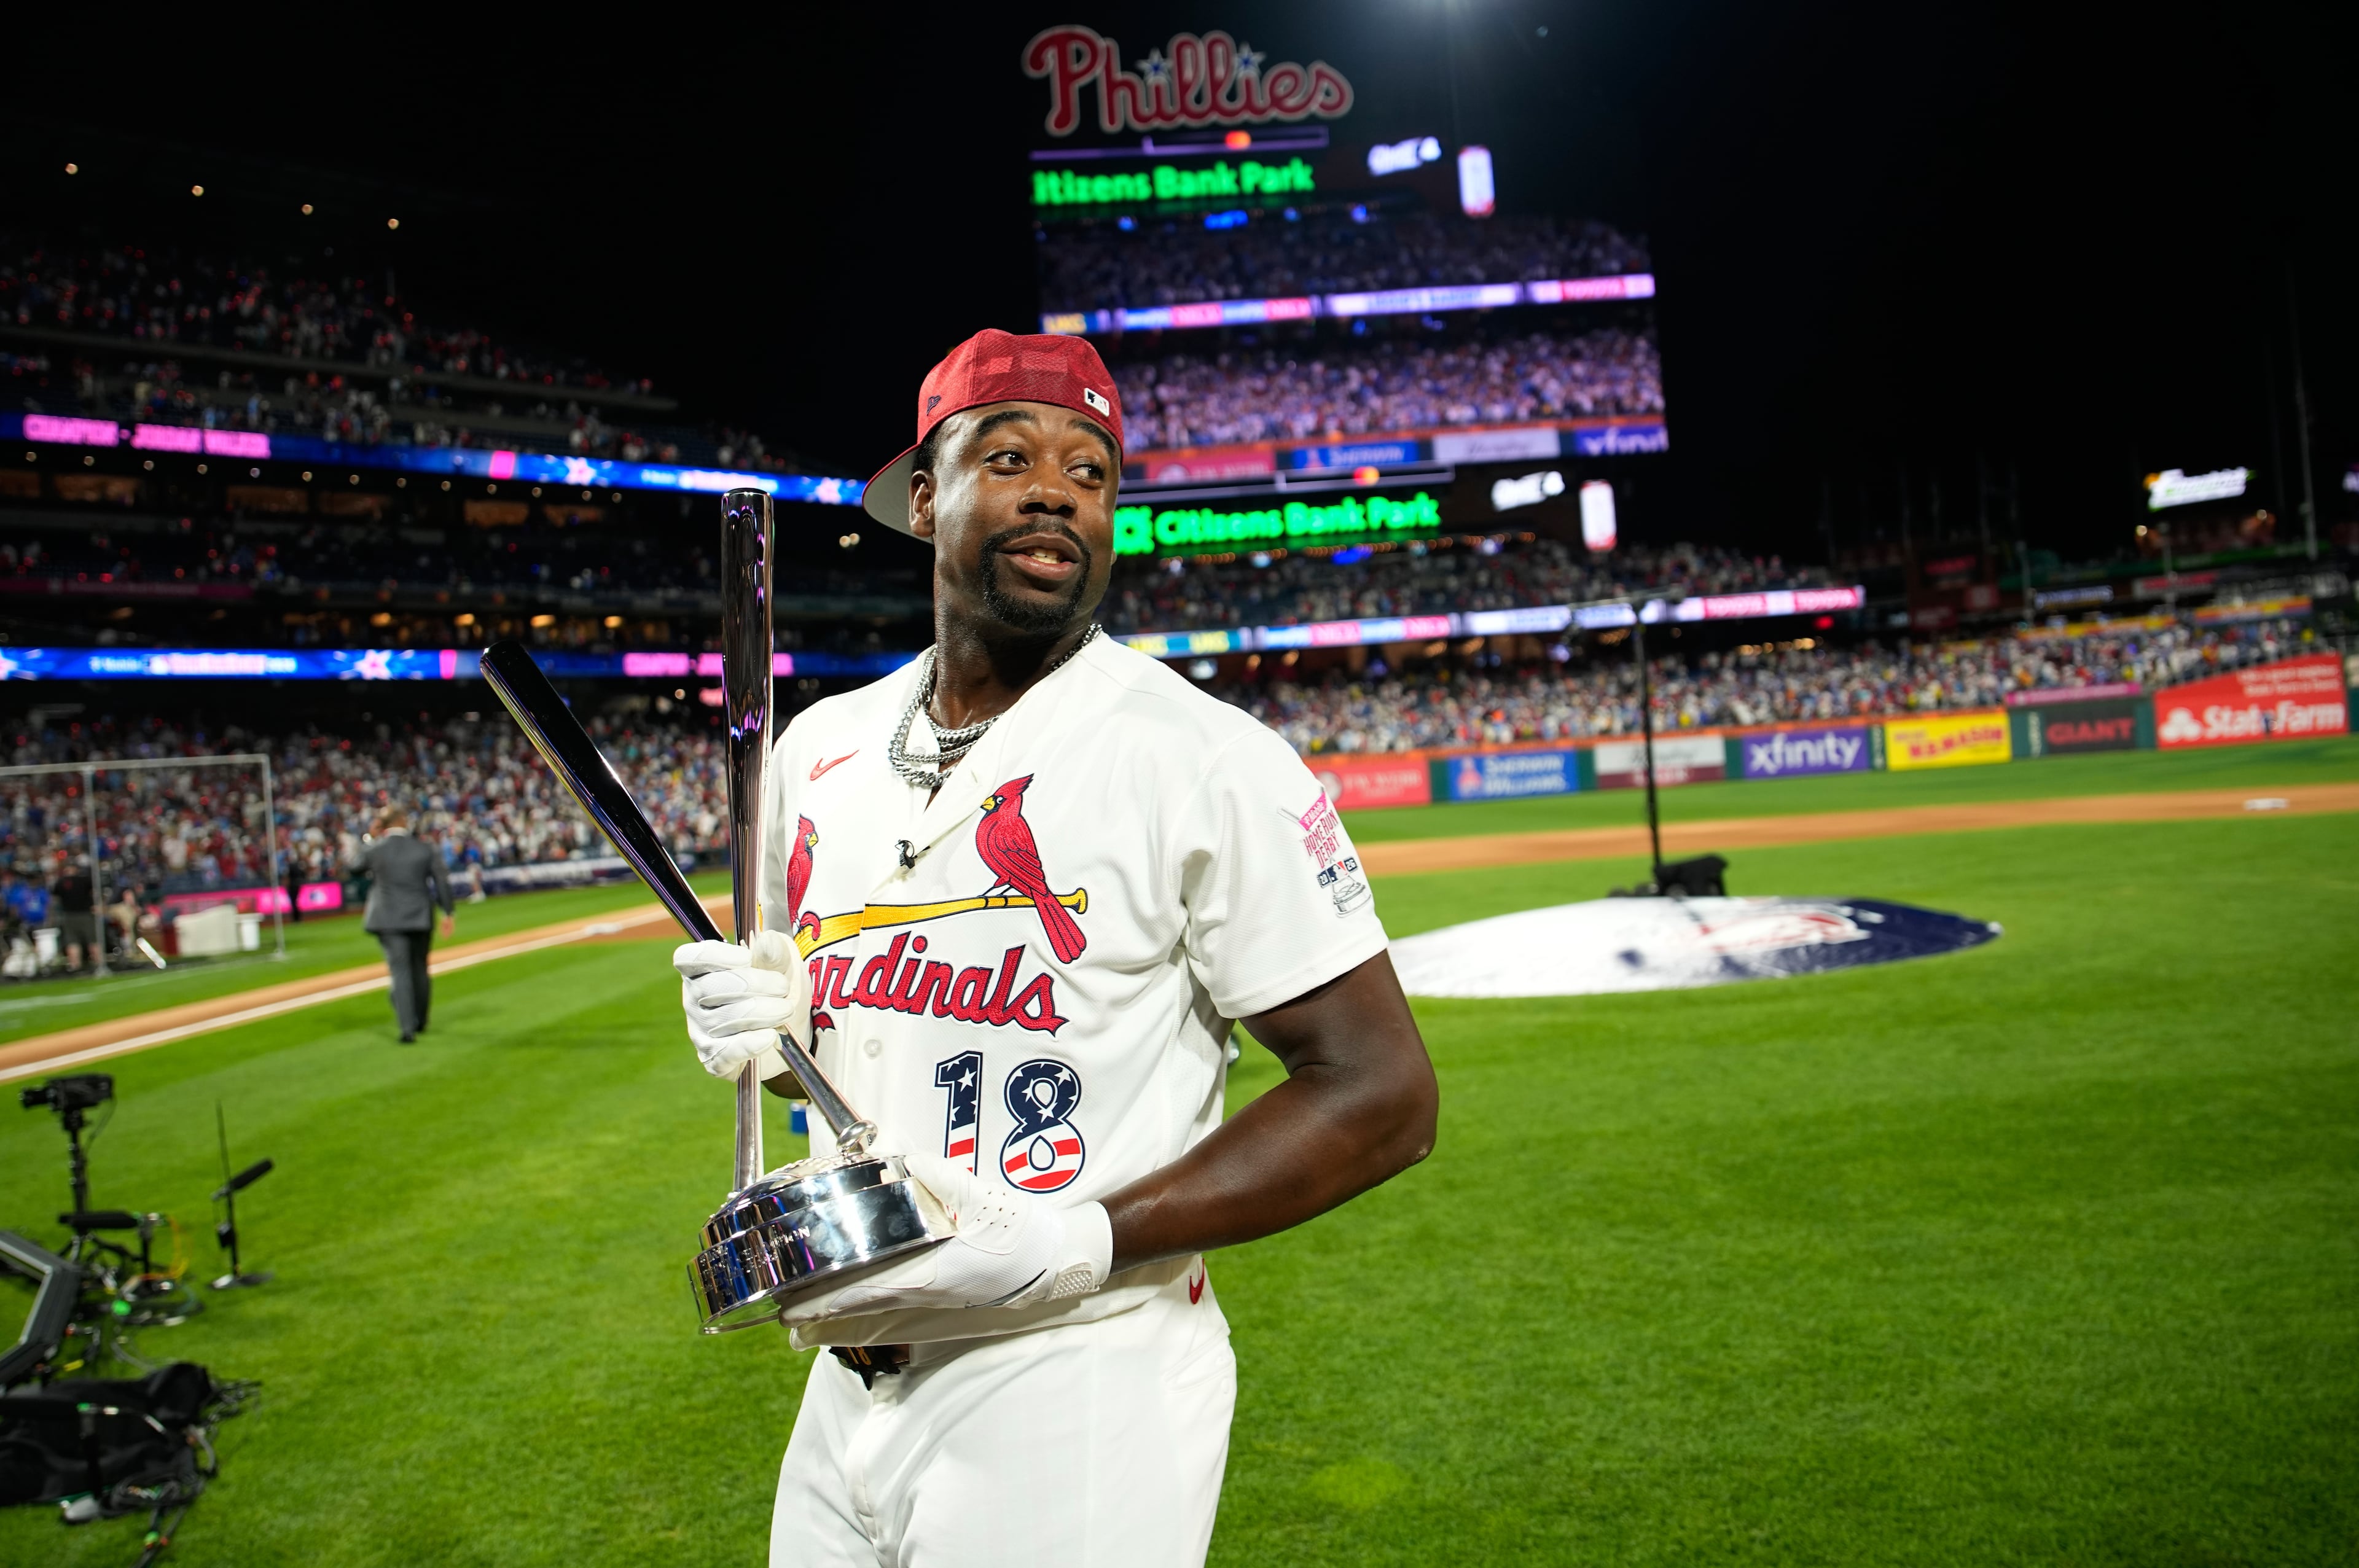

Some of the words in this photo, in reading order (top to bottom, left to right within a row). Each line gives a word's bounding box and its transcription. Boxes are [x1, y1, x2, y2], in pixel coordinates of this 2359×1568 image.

[1022, 25, 1354, 137] Phillies
[1032, 170, 1152, 205] itizens
[1153, 160, 1239, 199] Bank
[1240, 156, 1315, 194] Park
[1154, 508, 1284, 545] Citizens
[1283, 496, 1367, 536] Bank
[1367, 491, 1441, 529] Park
[2047, 718, 2135, 744] GIANT
[2204, 703, 2264, 739] Stat
[2276, 700, 2345, 733] Farm
[1750, 732, 1861, 773] xfinity
[1303, 825, 1325, 857] HOME
[1320, 809, 1339, 833] RUN
[1315, 831, 1340, 869] DERBY
[809, 930, 1070, 1038] ardinals
[934, 1050, 1086, 1194] 18
